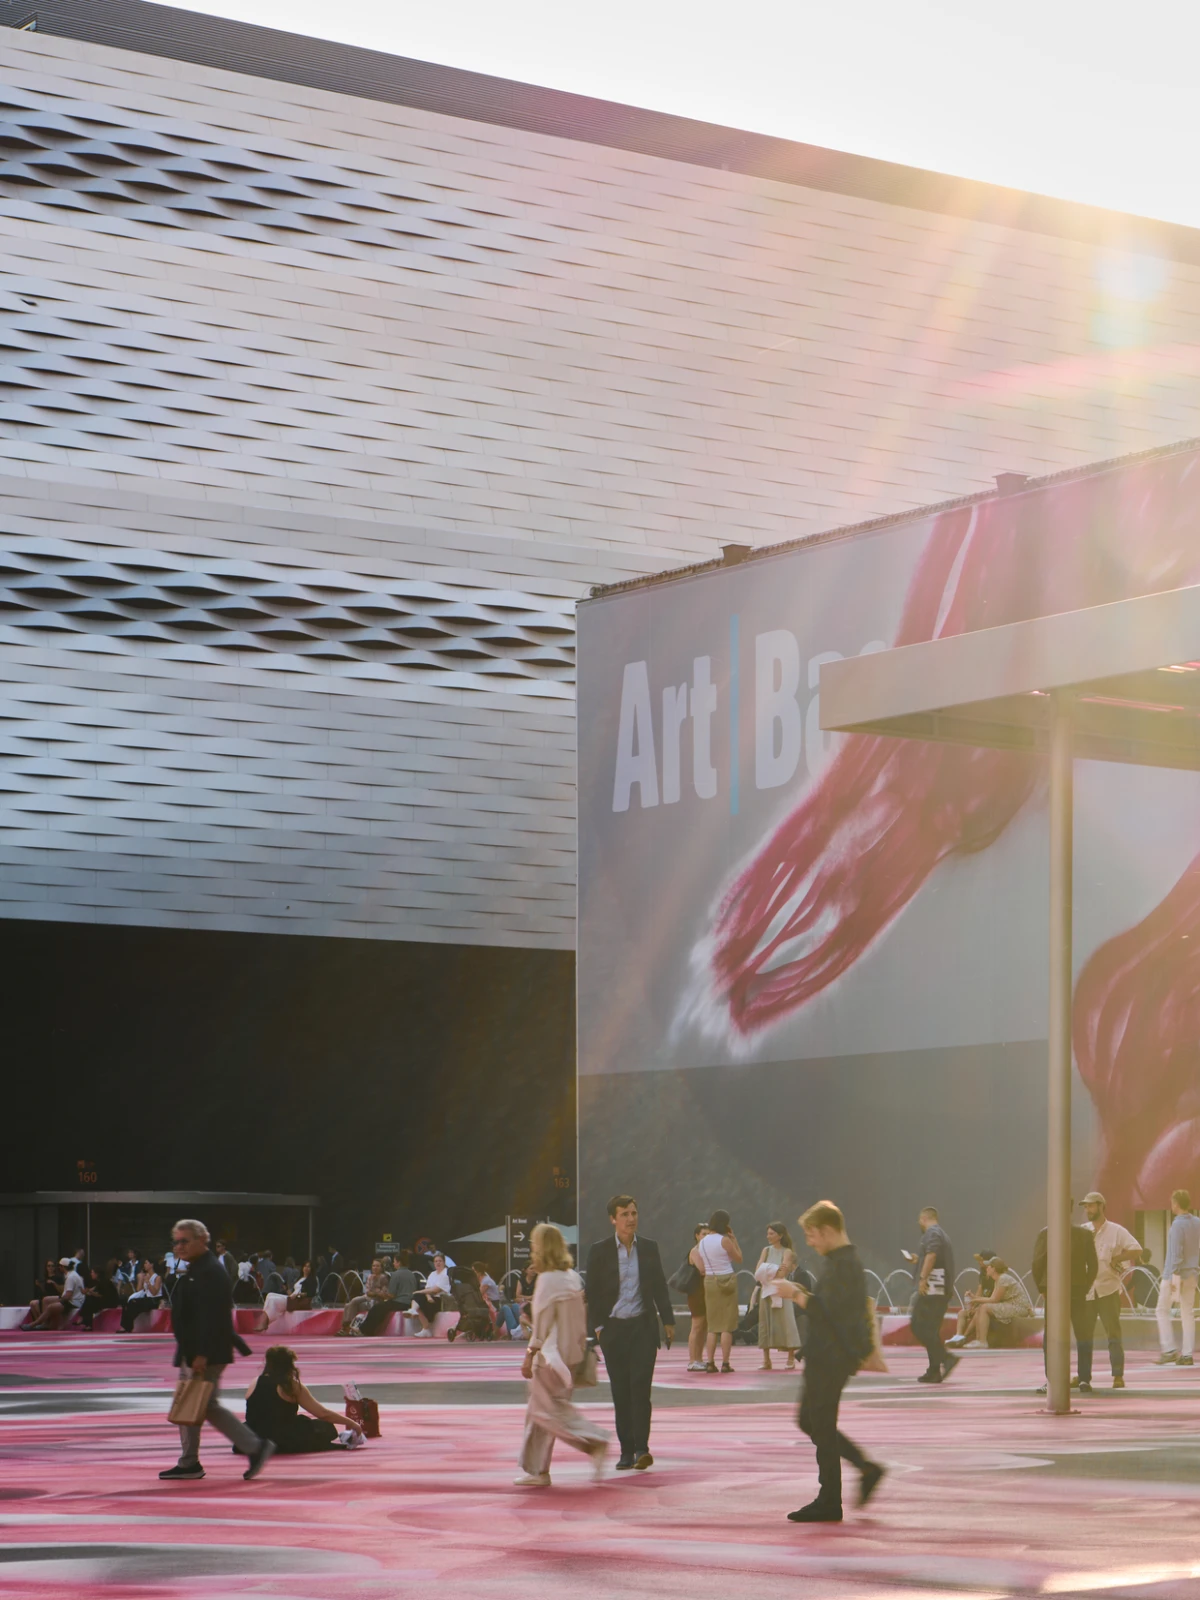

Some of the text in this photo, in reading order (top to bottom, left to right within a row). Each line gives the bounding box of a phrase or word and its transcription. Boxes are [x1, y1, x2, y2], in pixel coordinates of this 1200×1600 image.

[612, 655, 718, 813] Art
[78, 1171, 98, 1183] 160
[554, 1177, 570, 1189] 163
